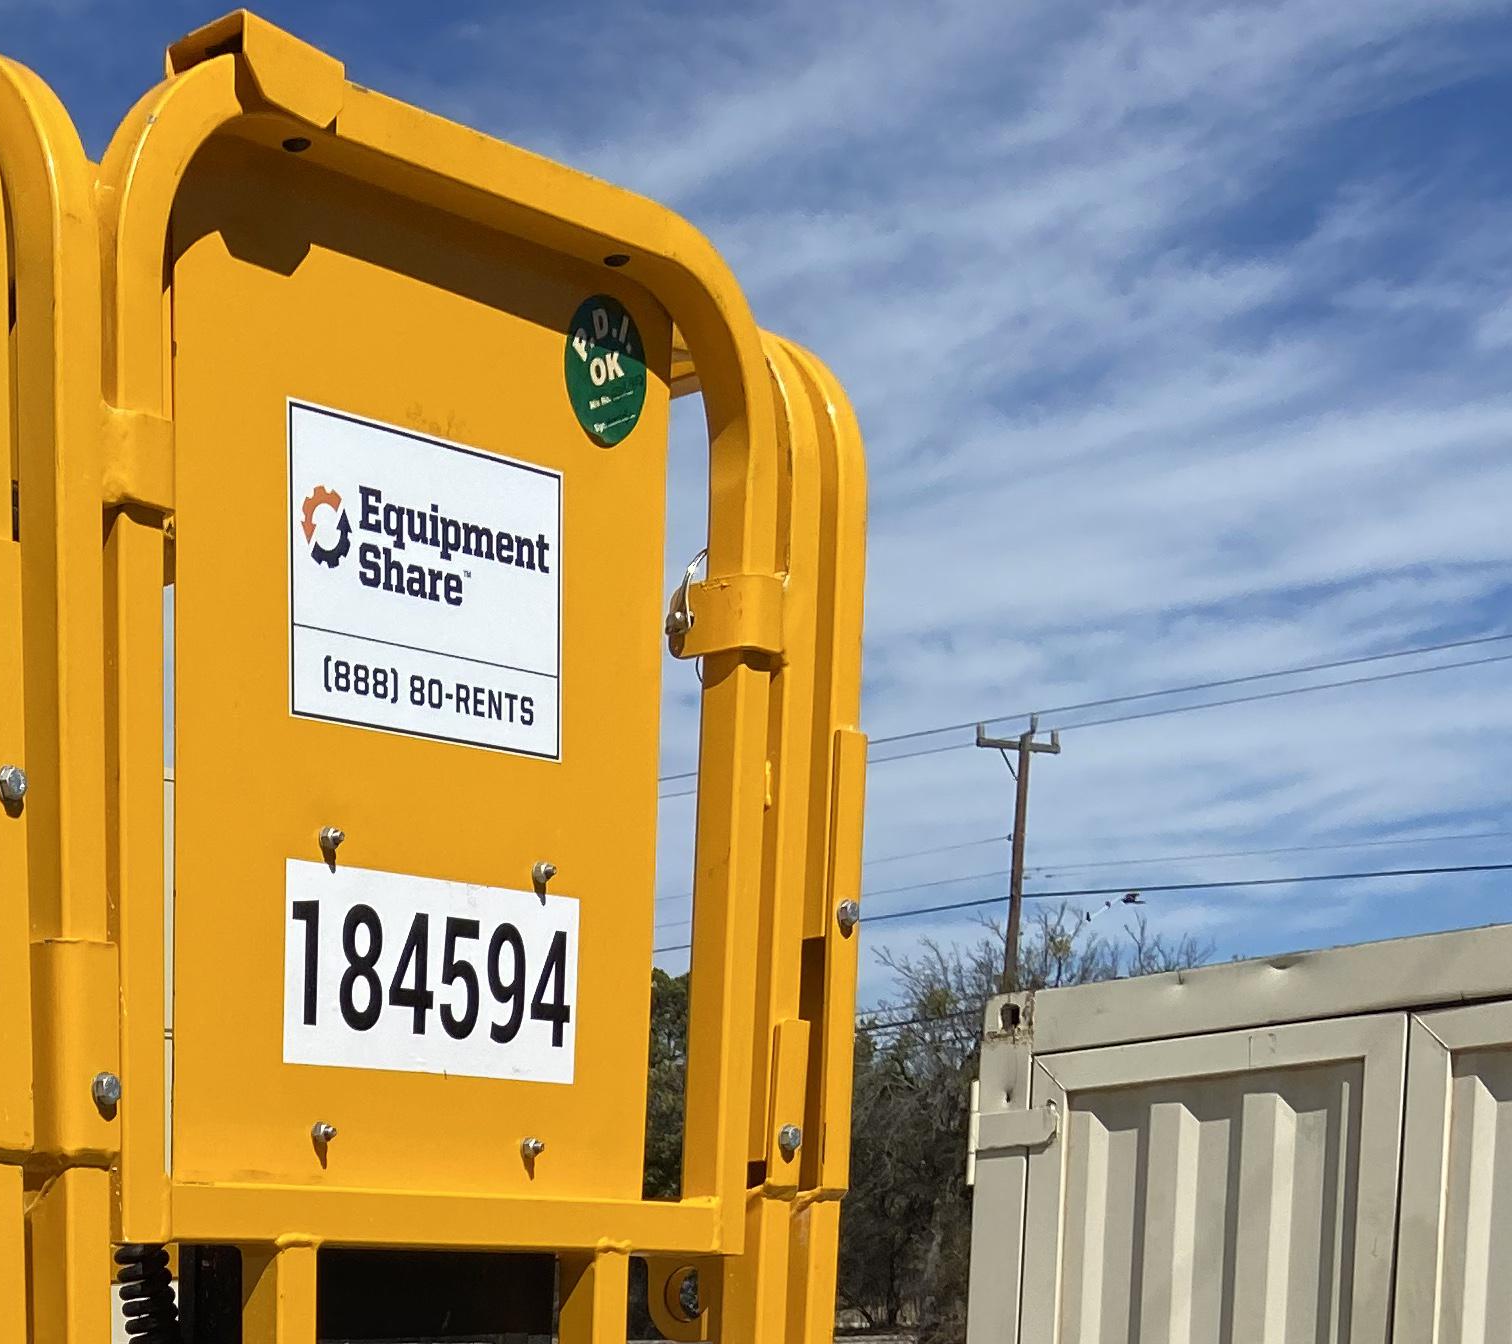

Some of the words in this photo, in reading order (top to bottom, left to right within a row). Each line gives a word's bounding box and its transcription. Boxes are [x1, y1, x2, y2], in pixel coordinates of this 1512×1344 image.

[589, 350, 624, 387] OK
[358, 485, 550, 574] Equipment
[359, 542, 463, 607] Share
[324, 655, 399, 704] (888)
[409, 674, 534, 726] 80-RENTS
[292, 899, 571, 1048] 184594
